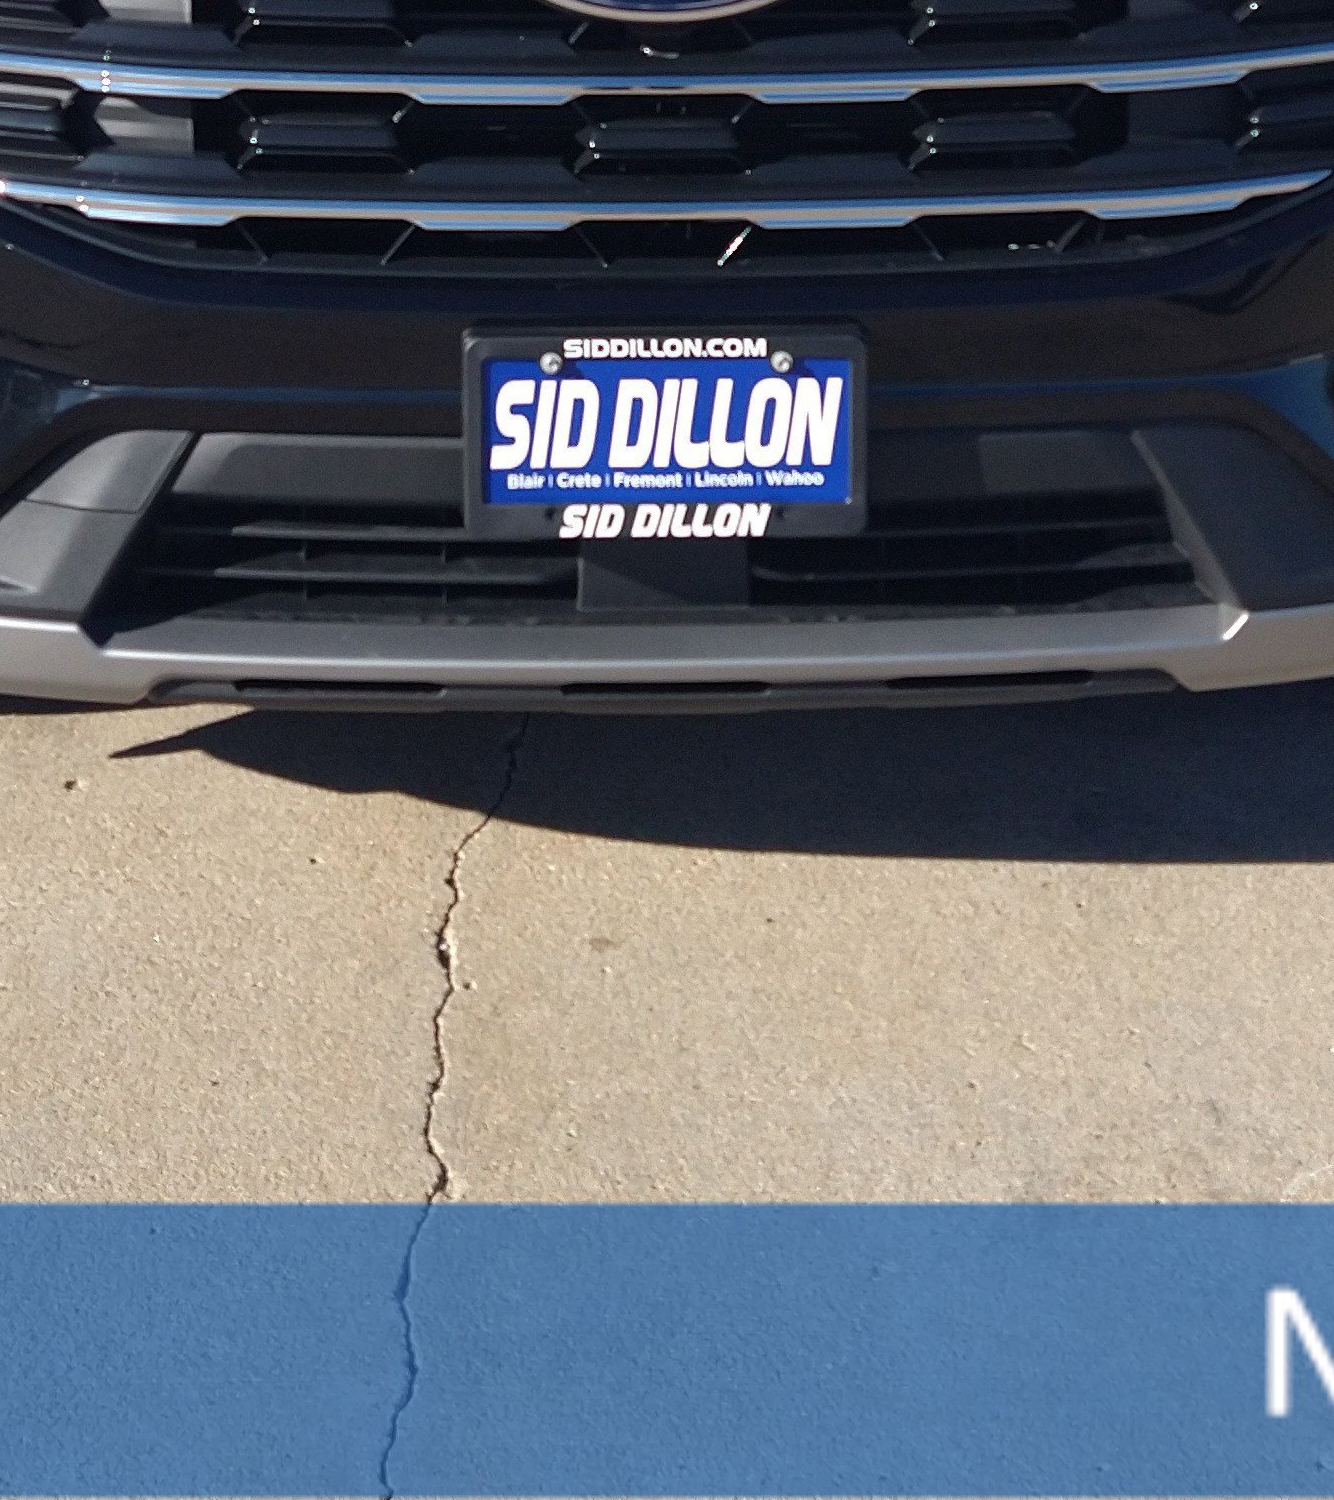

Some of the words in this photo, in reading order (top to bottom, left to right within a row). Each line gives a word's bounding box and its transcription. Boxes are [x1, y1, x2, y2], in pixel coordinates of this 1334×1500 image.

[563, 338, 767, 358] SIDDILLON.COM
[490, 379, 599, 470] SID
[608, 378, 843, 468] DILLON
[507, 472, 546, 489] Blair
[556, 472, 601, 488] Crete
[613, 471, 683, 488] Fremont
[694, 470, 754, 487] Lincoln
[765, 470, 825, 486] Wahoo
[559, 503, 625, 538] SID
[631, 503, 771, 538] DILLON
